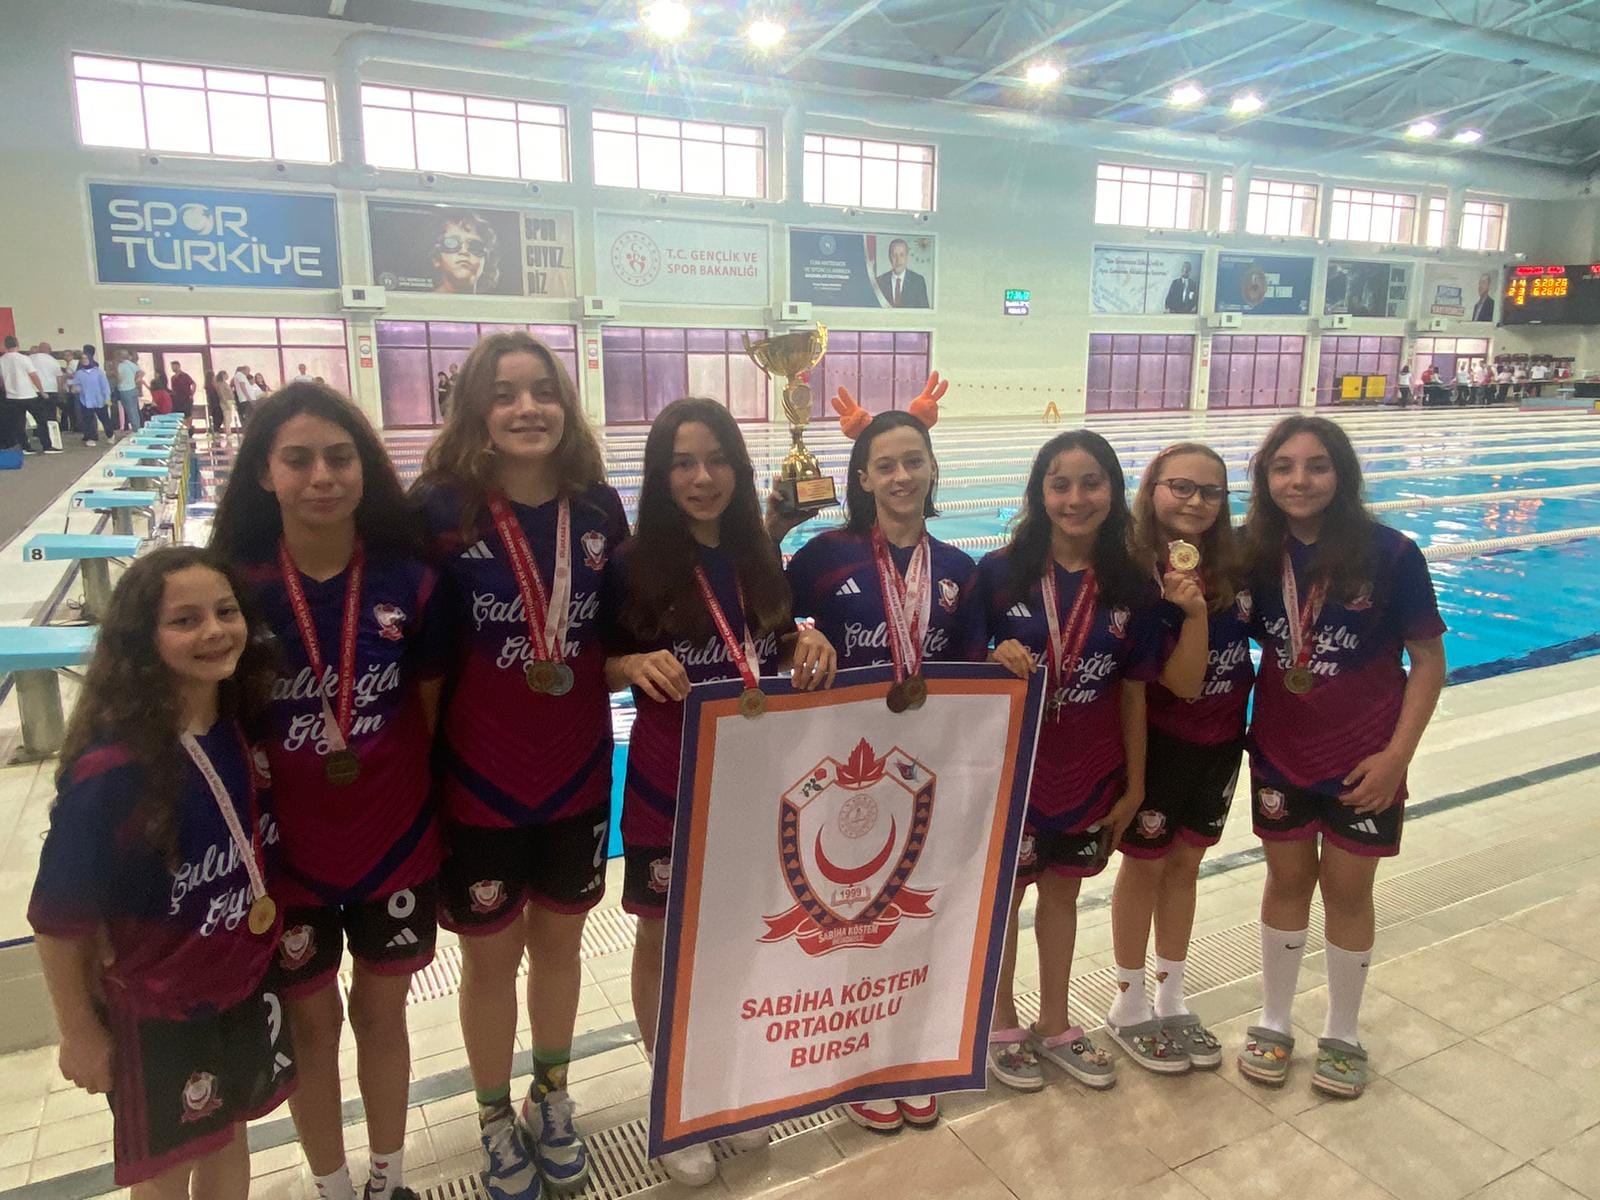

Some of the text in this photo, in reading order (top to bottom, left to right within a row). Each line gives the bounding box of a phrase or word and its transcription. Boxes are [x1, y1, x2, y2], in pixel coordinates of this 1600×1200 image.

[108, 199, 249, 238] SPOR
[112, 231, 323, 276] TÜRKİYE
[666, 248, 758, 264] T.C. GENÇLİK VE
[667, 263, 758, 277] SPOR BAKANLIĞI
[107, 469, 114, 478] 6
[75, 498, 84, 507] 7
[31, 548, 43, 560] 8
[840, 888, 862, 899] 1999
[740, 965, 929, 1020] SABİHA KÖSTEM
[766, 996, 903, 1042] ORTAOKULU
[790, 1032, 870, 1068] BURSA
